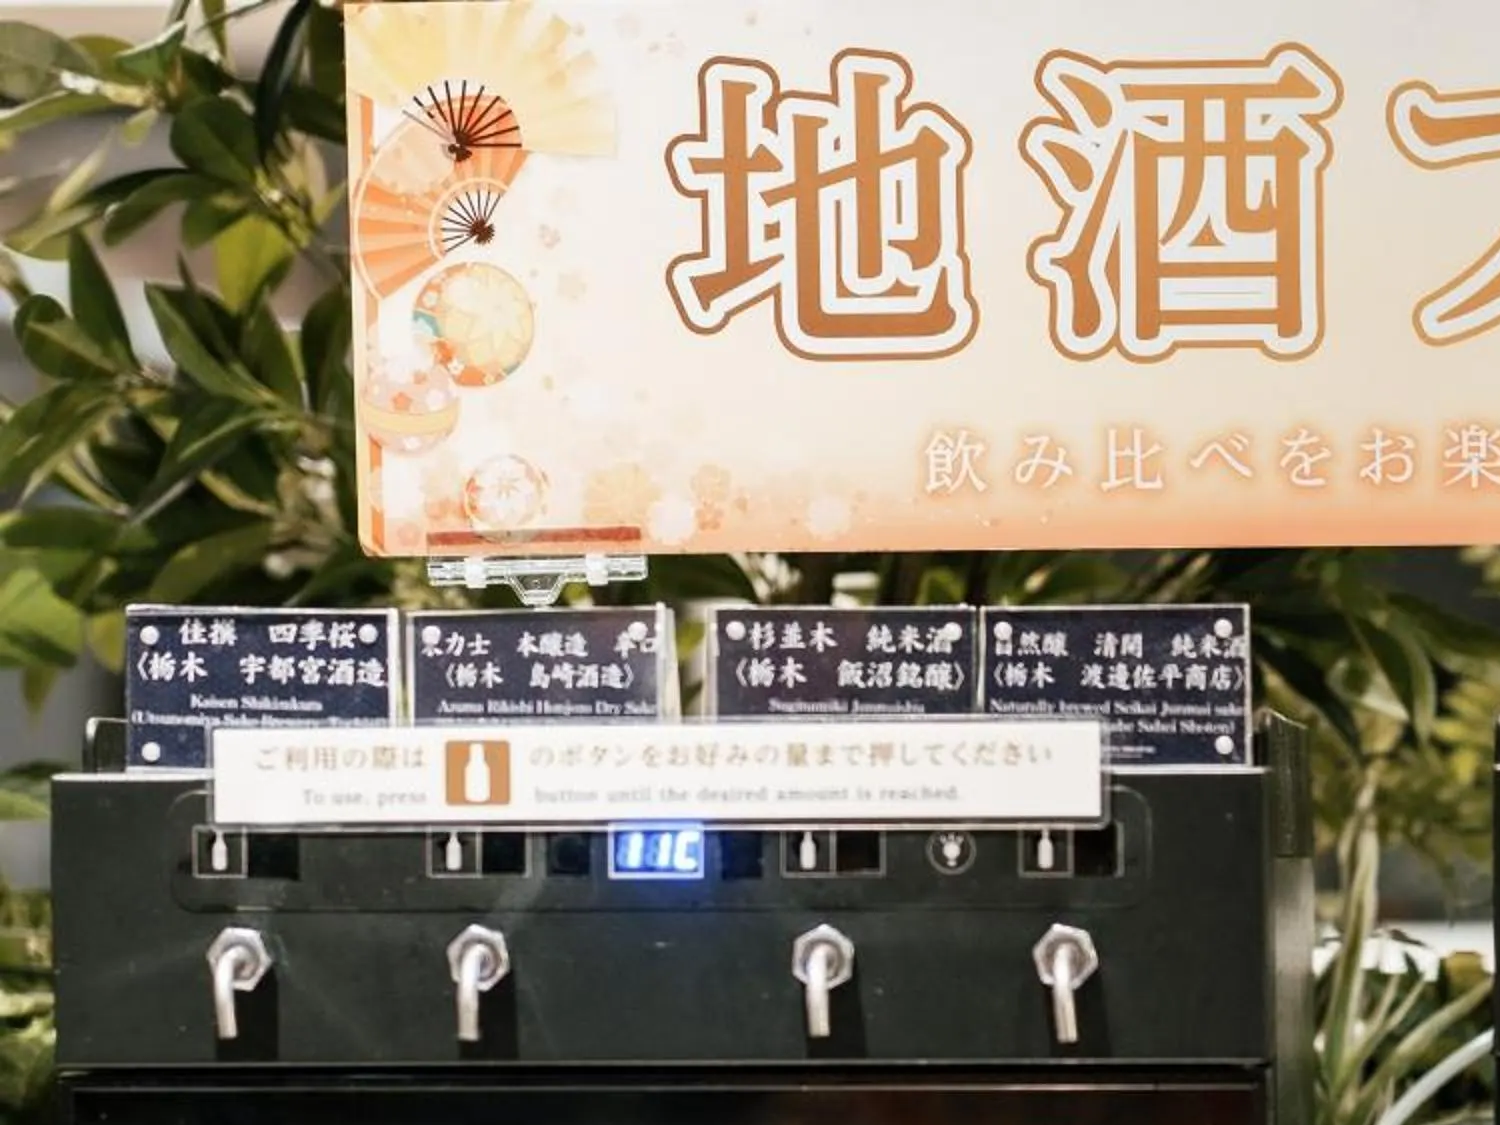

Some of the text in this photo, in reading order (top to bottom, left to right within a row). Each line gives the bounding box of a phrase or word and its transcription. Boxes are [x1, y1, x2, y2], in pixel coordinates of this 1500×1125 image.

[268, 621, 357, 650] 四季桜
[749, 621, 838, 652] 杉並木
[256, 741, 1052, 772] ご利用の際は のボタンをお好みの量まで押してください
[303, 788, 324, 805] To
[377, 791, 426, 808] press
[534, 786, 598, 803] button
[608, 787, 651, 803] until
[659, 786, 688, 802] the
[697, 786, 768, 802] desired
[777, 787, 848, 802] amount
[857, 785, 872, 800] is
